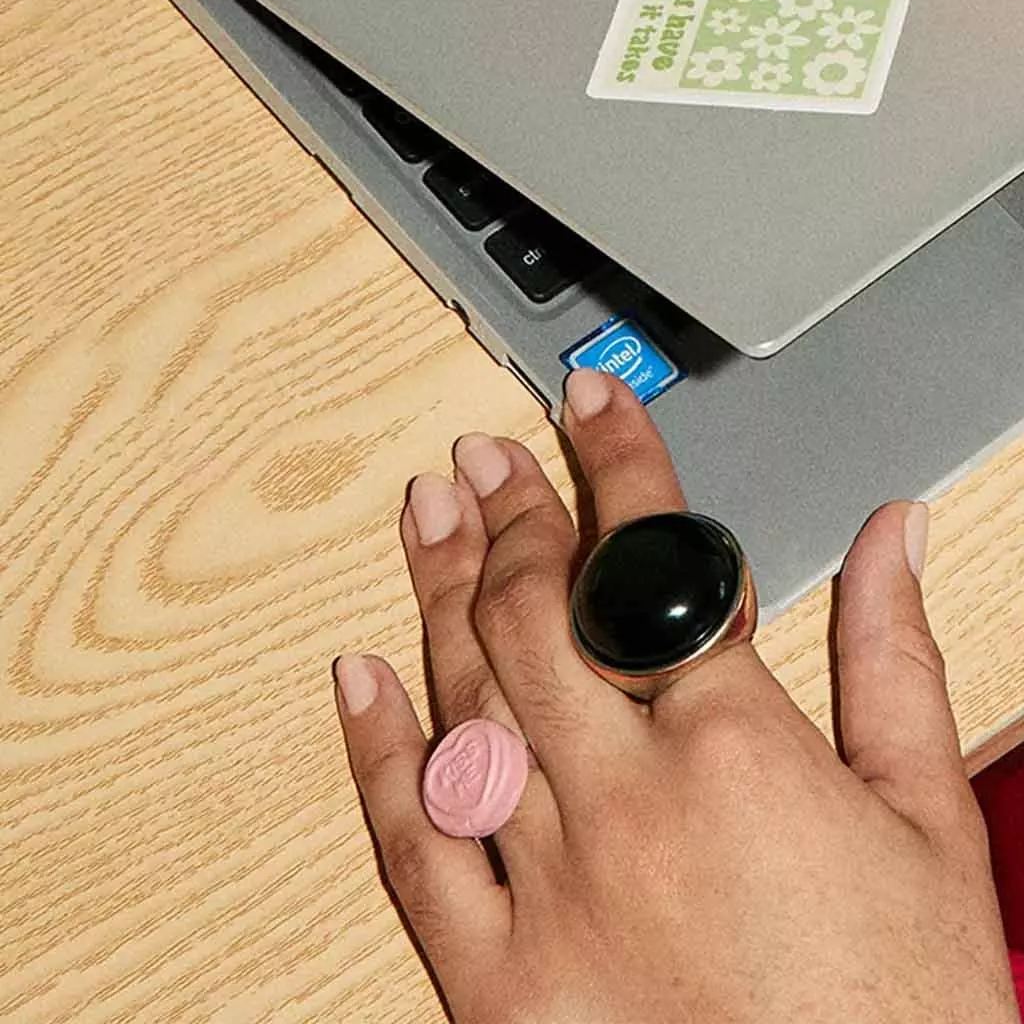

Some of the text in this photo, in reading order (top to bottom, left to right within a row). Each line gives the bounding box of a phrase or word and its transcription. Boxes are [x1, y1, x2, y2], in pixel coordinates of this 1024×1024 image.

[640, 4, 665, 20] it
[616, 25, 657, 82] takes
[652, 15, 696, 71] have
[598, 342, 638, 373] intel
